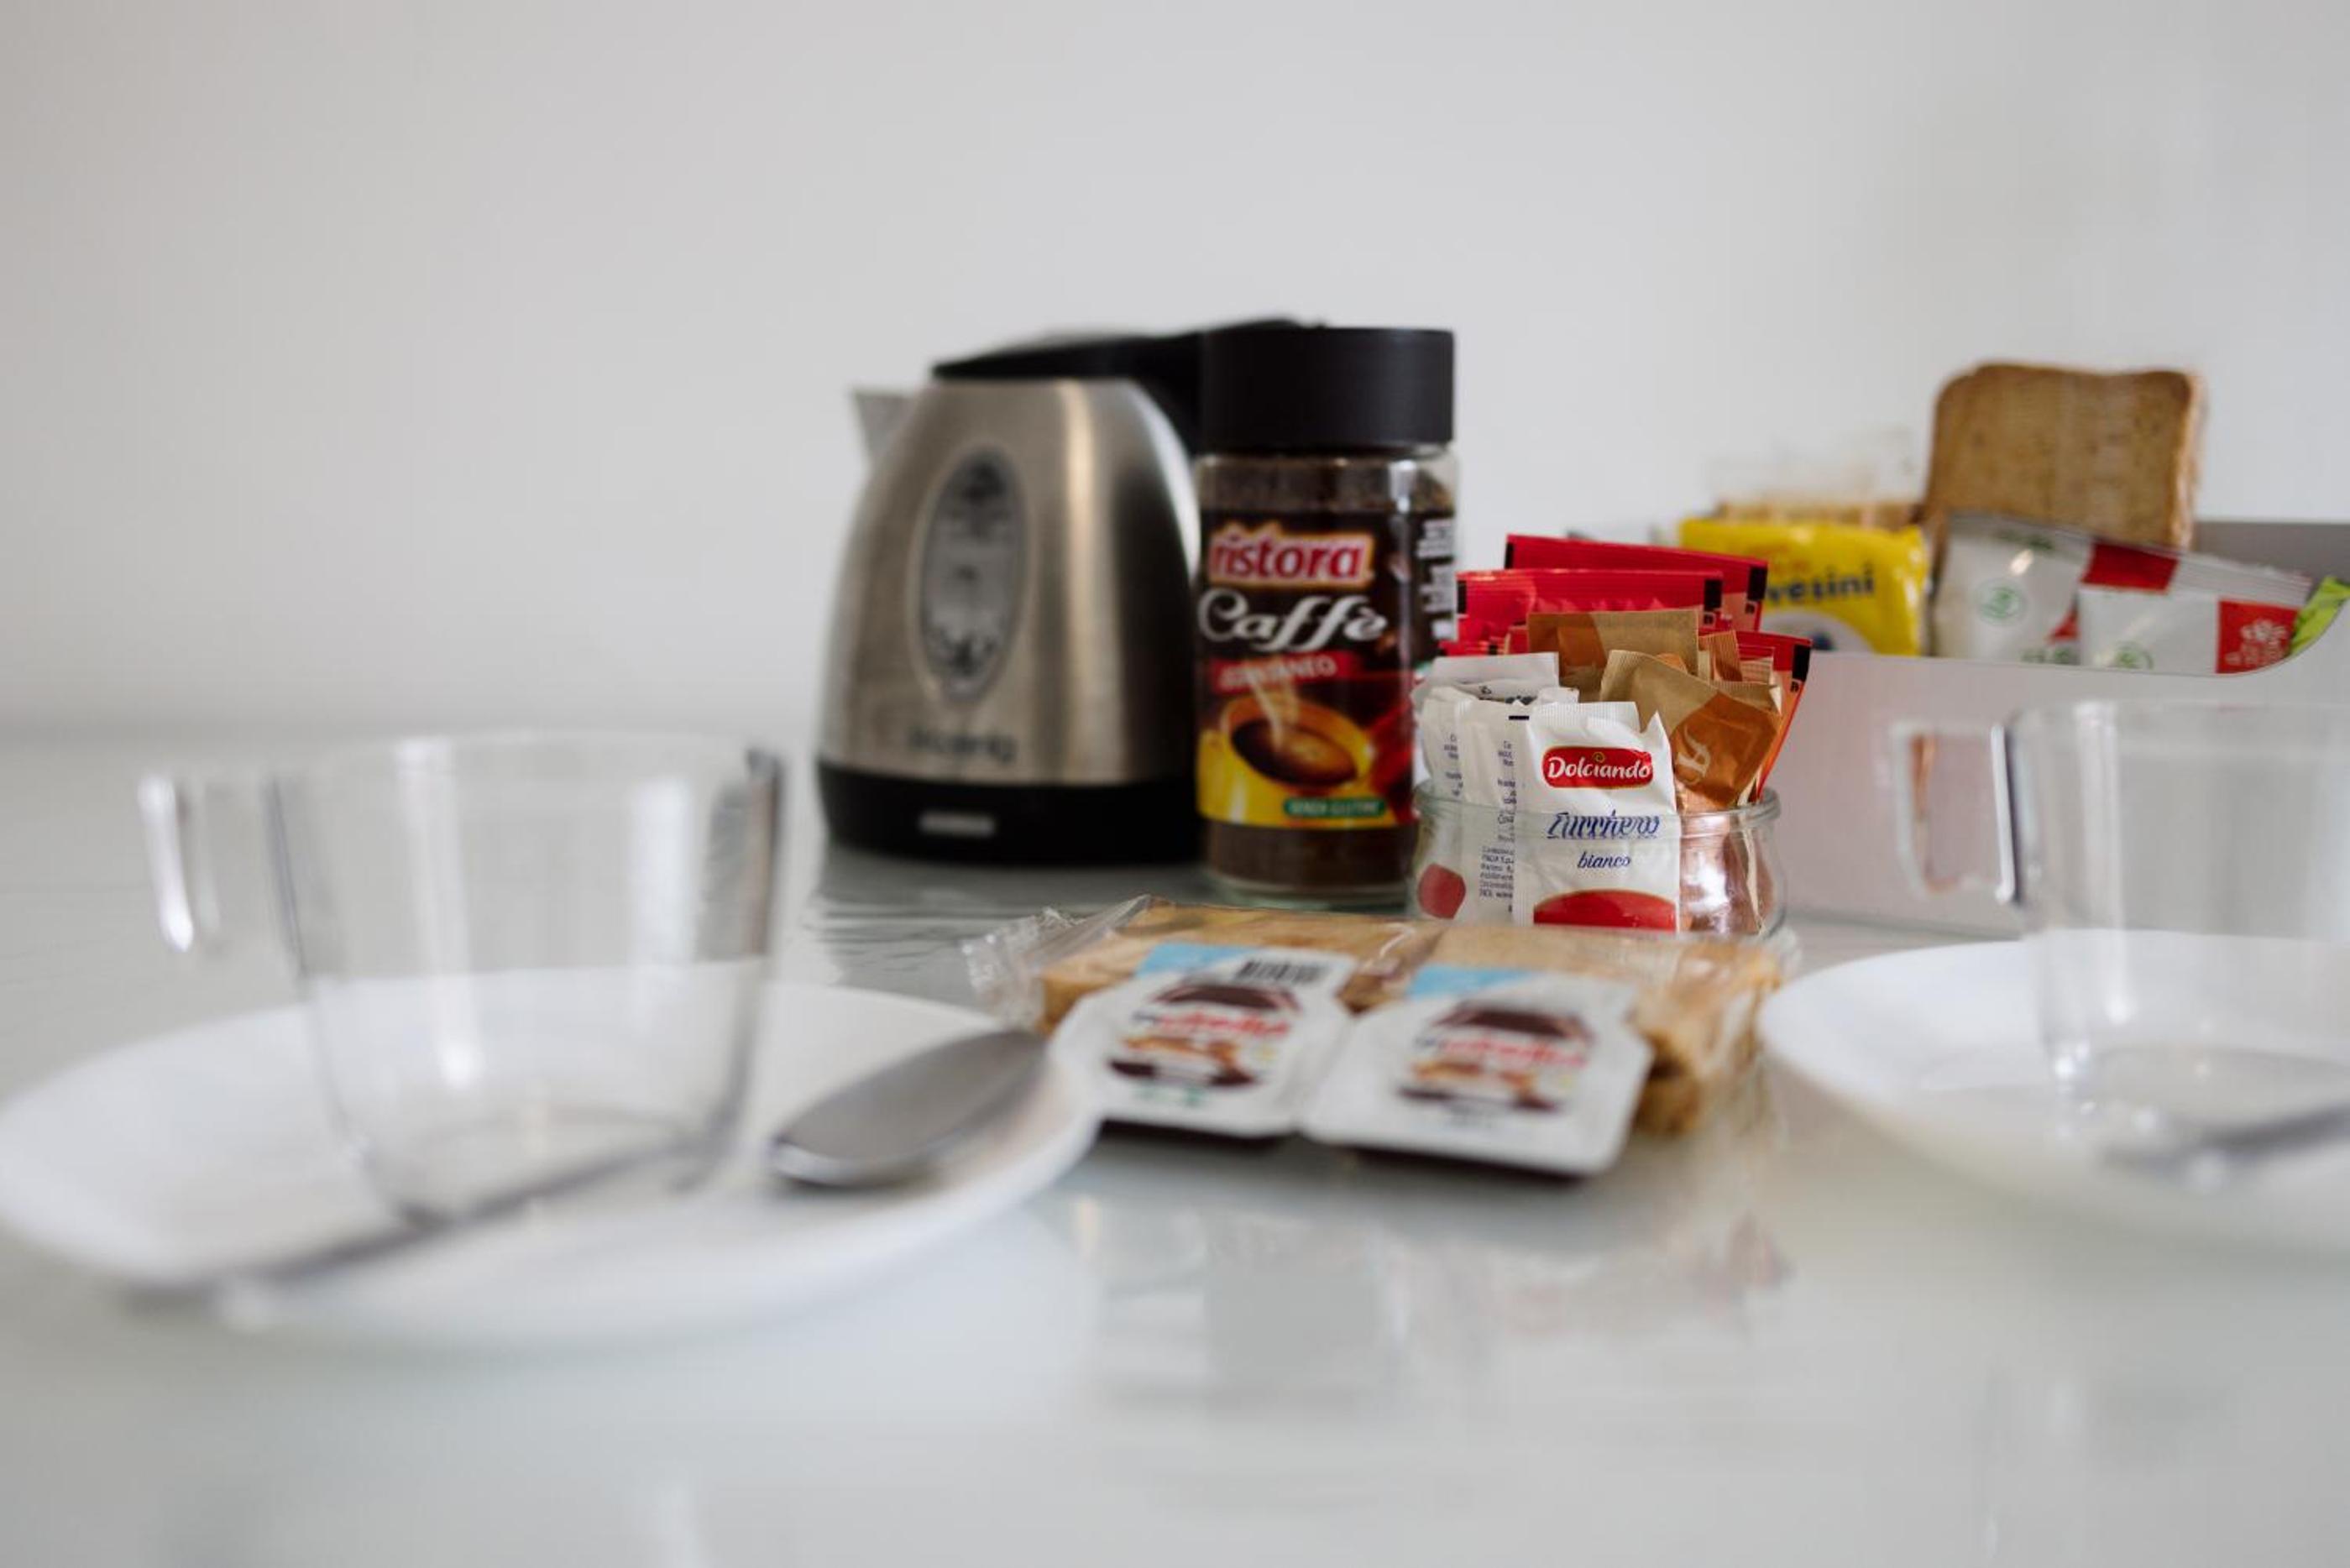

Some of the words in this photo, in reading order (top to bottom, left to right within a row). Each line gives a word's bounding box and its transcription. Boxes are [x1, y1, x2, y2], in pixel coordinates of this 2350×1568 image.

[1212, 531, 1364, 581] ristora
[1198, 588, 1388, 652] Caffè
[1547, 755, 1651, 779] Dolciando
[1577, 851, 1631, 869] bianco
